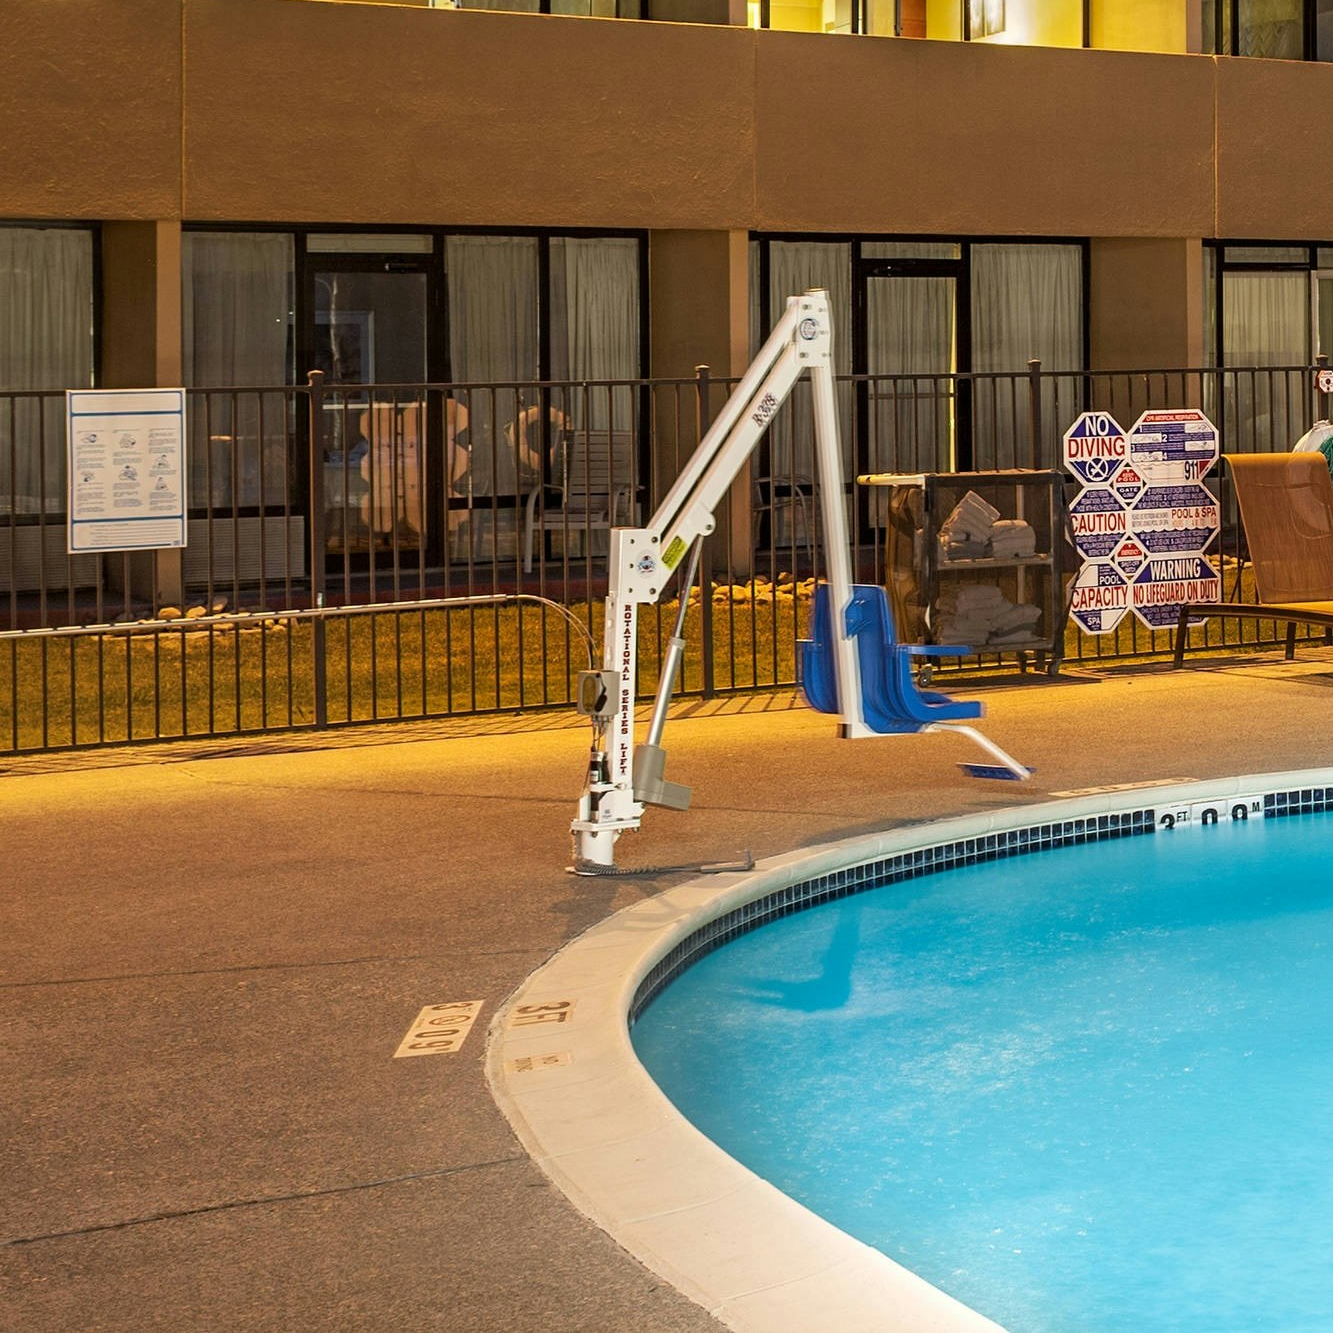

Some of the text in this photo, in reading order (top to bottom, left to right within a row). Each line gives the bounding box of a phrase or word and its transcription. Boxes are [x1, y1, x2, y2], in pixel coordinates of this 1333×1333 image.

[1085, 415, 1109, 436] NO
[1068, 437, 1125, 458] DIVING
[1184, 460, 1200, 480] 911
[1071, 513, 1126, 533] CAUTION
[1172, 509, 1193, 519] POOL
[1201, 507, 1217, 517] SPA
[1150, 559, 1201, 580] WARNING
[1099, 576, 1121, 585] POOL
[1072, 586, 1128, 608] CAPACITY
[1134, 580, 1219, 604] NO LIFEGUARD ON DUTY
[1087, 617, 1101, 625] SPA
[620, 604, 632, 774] ROTATIONAL SERIES LIFT
